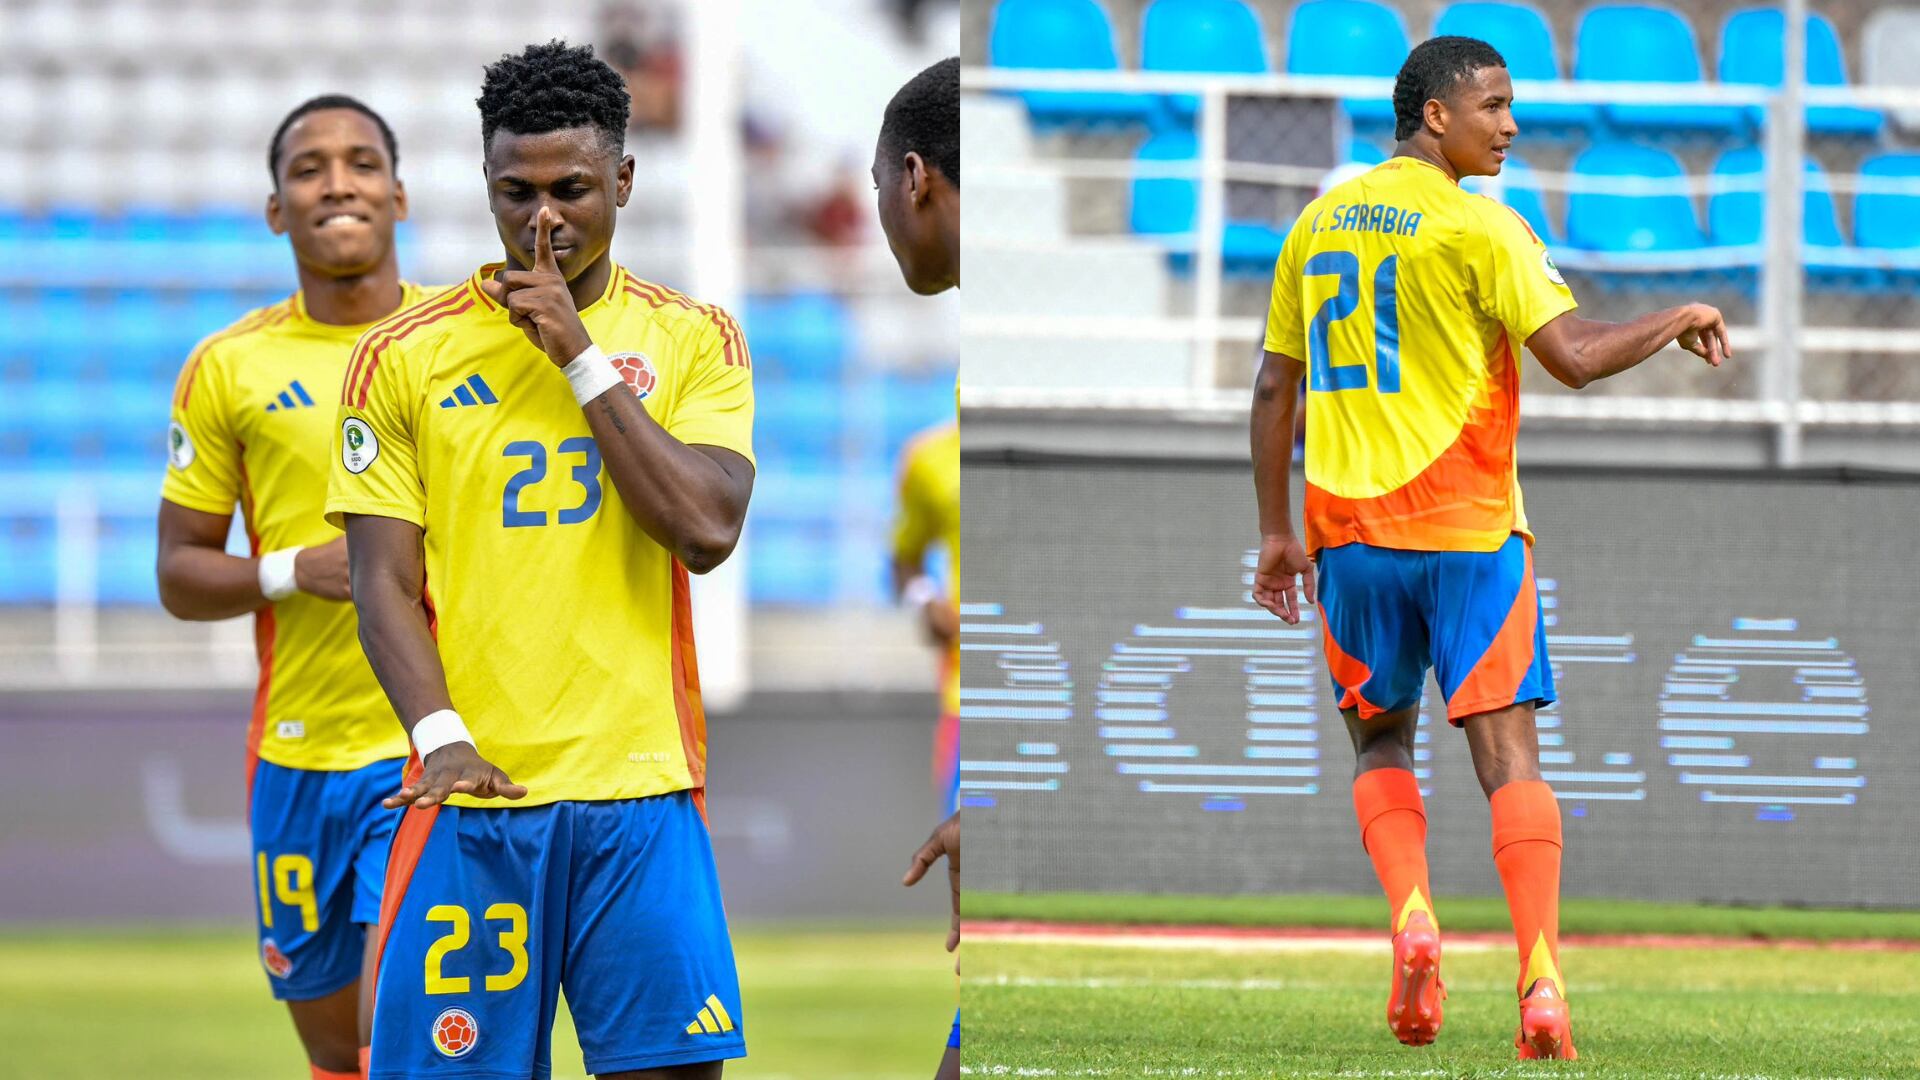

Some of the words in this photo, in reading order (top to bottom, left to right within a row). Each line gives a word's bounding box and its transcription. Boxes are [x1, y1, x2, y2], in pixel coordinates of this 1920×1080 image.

[1330, 203, 1423, 237] SARABIA
[1303, 250, 1401, 394] 21
[502, 437, 603, 528] 23
[257, 852, 320, 933] 19
[424, 903, 529, 995] 23
